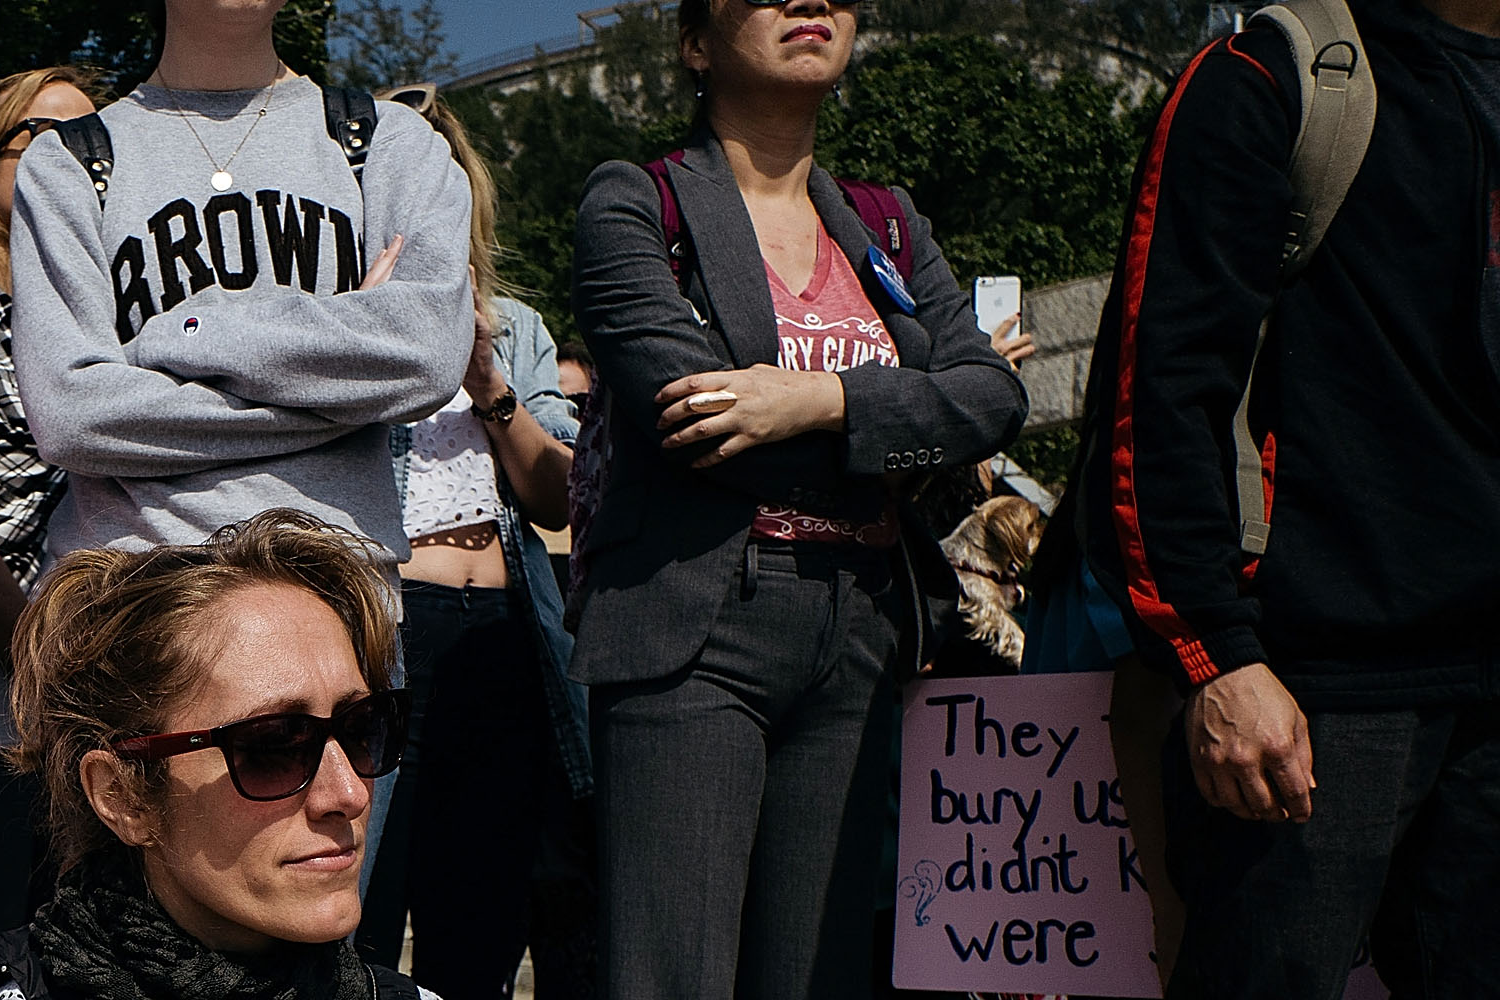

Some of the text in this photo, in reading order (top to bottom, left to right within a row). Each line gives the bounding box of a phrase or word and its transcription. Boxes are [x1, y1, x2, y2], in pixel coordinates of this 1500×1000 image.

[926, 693, 1079, 778] They
[930, 769, 1041, 851] bury
[945, 918, 1099, 967] were
